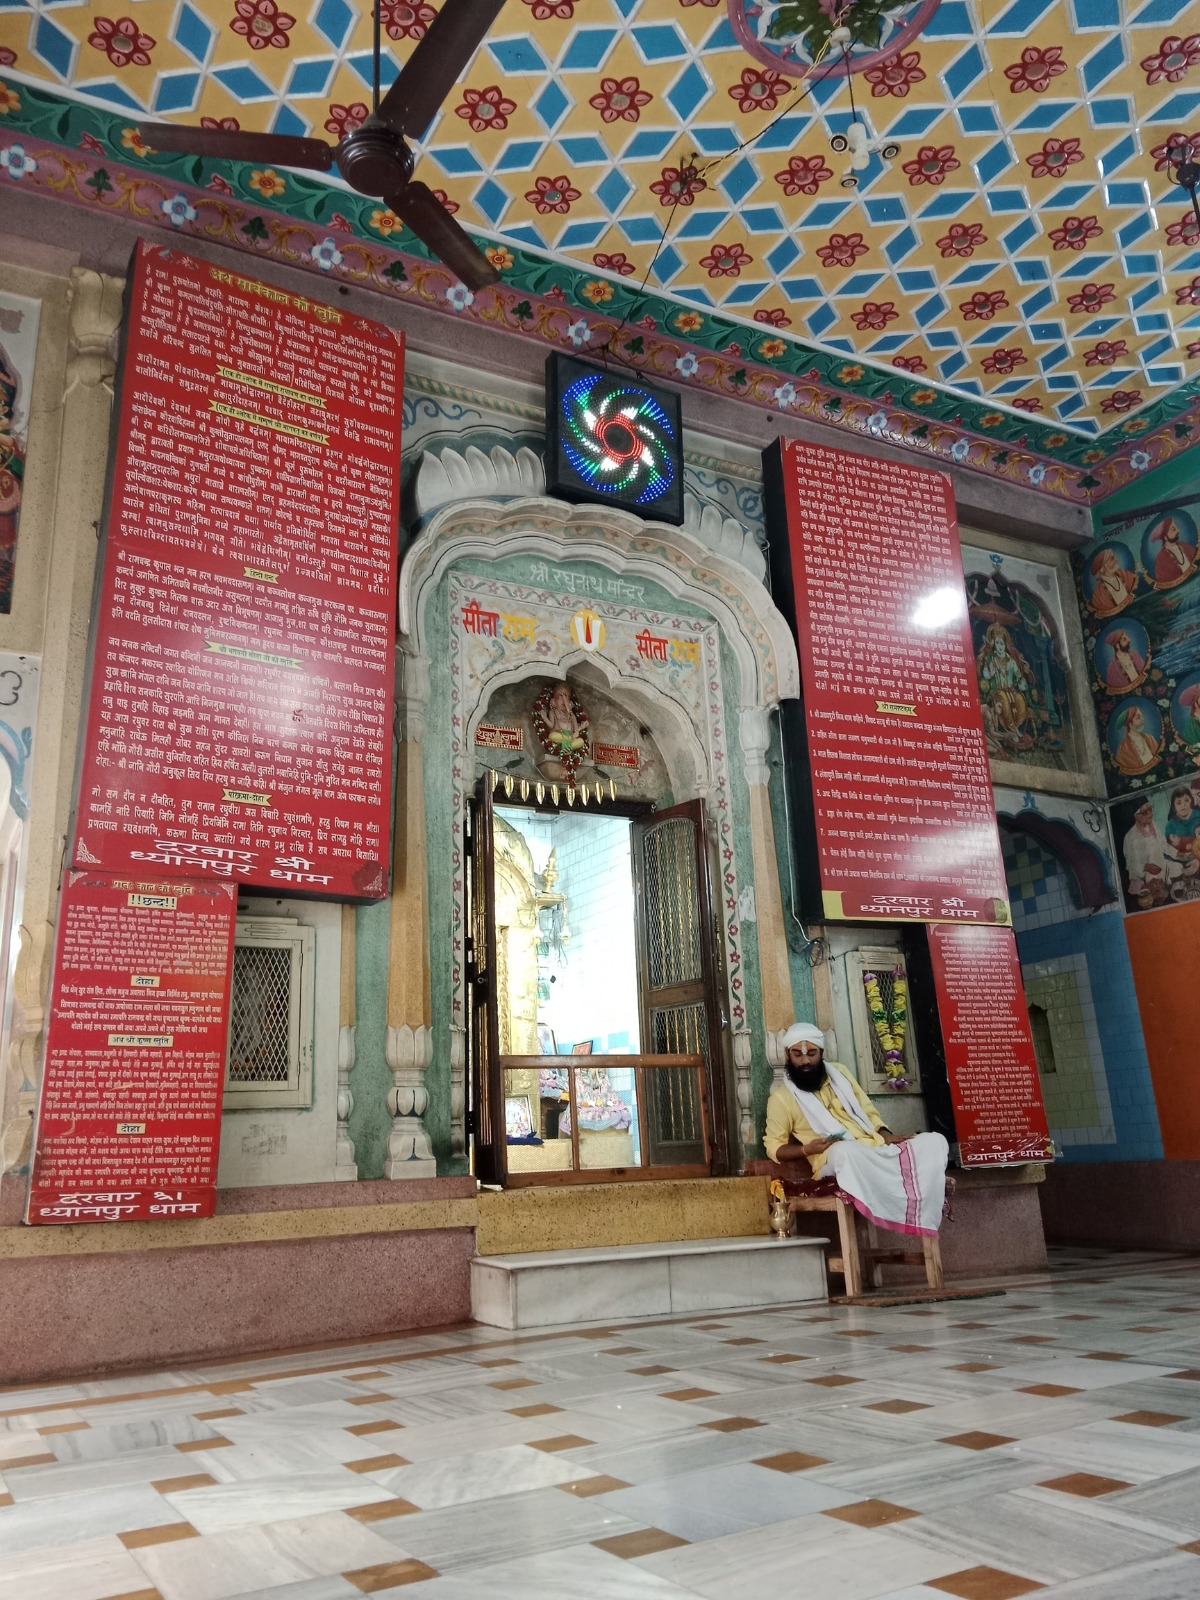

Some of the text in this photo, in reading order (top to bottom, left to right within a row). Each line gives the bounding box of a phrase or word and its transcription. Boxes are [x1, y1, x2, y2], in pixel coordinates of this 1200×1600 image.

[210, 266, 341, 327] अथ सायंकाल की स्तुति
[530, 562, 645, 603] श्री रघुनाथ मन्दिर
[461, 601, 538, 644] सीता राम
[635, 629, 700, 667] सीता राम
[91, 784, 101, 797] मो
[105, 789, 119, 800] सम
[123, 788, 136, 802] दीन
[140, 793, 147, 803] न
[181, 799, 193, 810] तुम
[196, 801, 216, 812] समान
[244, 807, 257, 817] अस
[260, 806, 280, 821] विचारि
[334, 816, 350, 830] विषम
[353, 821, 363, 831] भव
[152, 839, 315, 870] दरबार श्री
[129, 849, 333, 885] ध्यानपुर धाम
[112, 880, 192, 897] प्रातः काल की स्तुति
[131, 894, 175, 907] !!छन्द!!
[871, 895, 967, 908] दरबार श्री
[860, 904, 980, 917] ध्यानपुर धाम
[135, 977, 154, 985] दोहा
[125, 1035, 135, 1043] श्री
[153, 1035, 169, 1045] स्तुति
[120, 1123, 140, 1133] दोहा
[59, 1191, 141, 1204] दरबार
[40, 1202, 201, 1219] ध्यानपुर धाम
